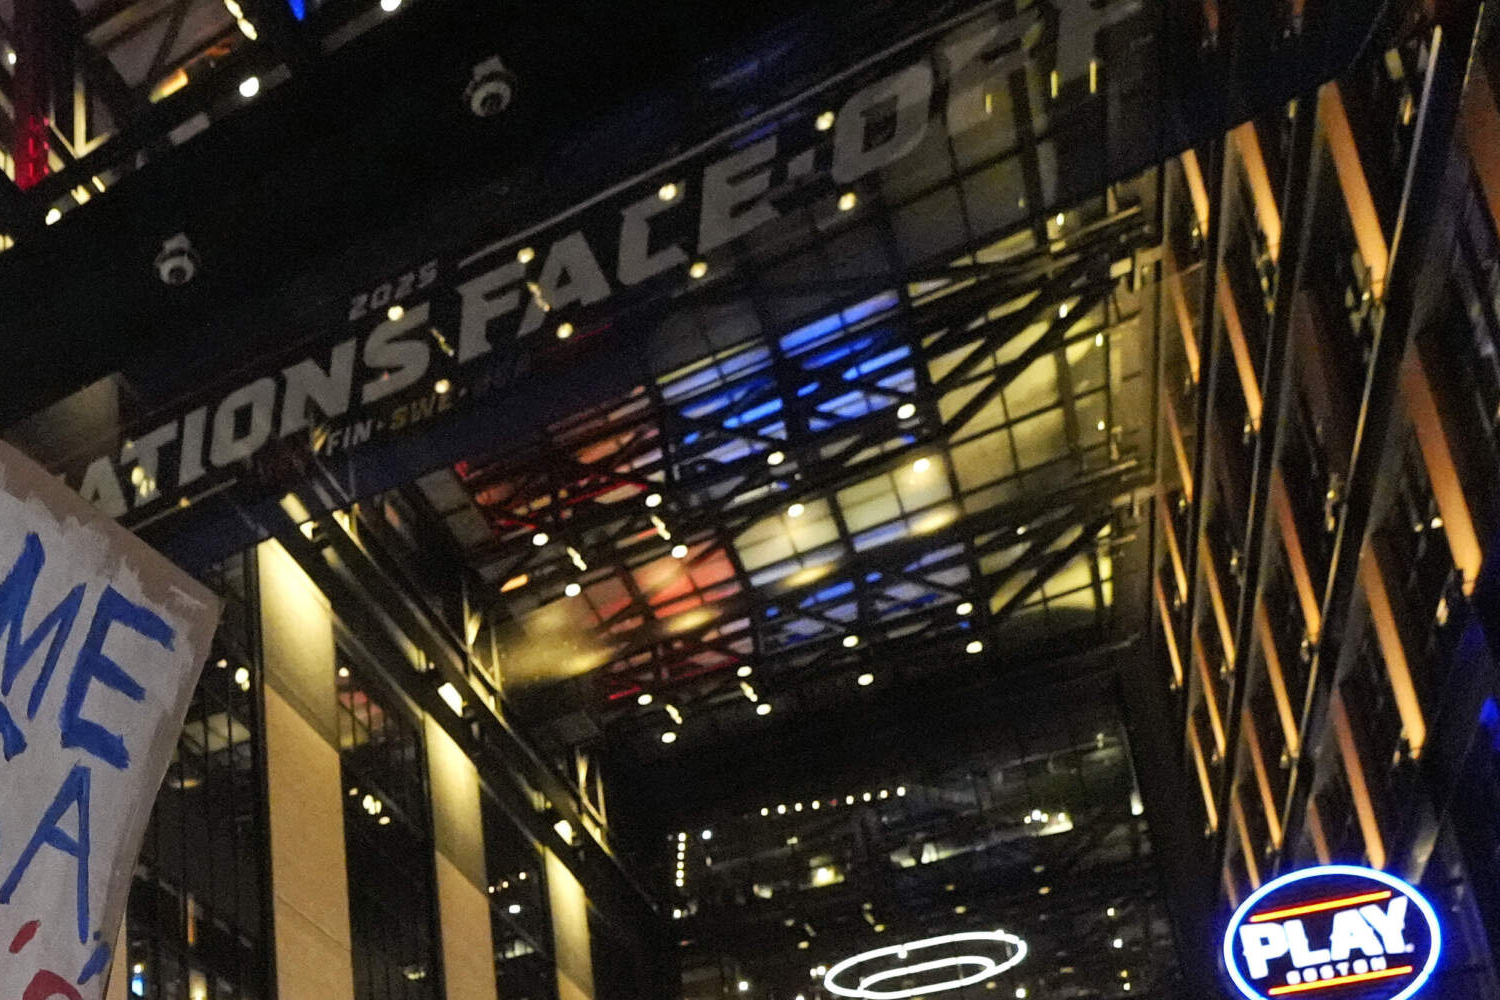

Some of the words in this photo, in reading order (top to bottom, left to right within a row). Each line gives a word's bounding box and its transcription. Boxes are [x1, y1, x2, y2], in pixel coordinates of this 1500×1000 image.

[348, 260, 439, 322] 2025
[76, 302, 431, 517] ATIONS
[1240, 896, 1409, 980] PLAY
[1286, 956, 1388, 986] BOSTON
